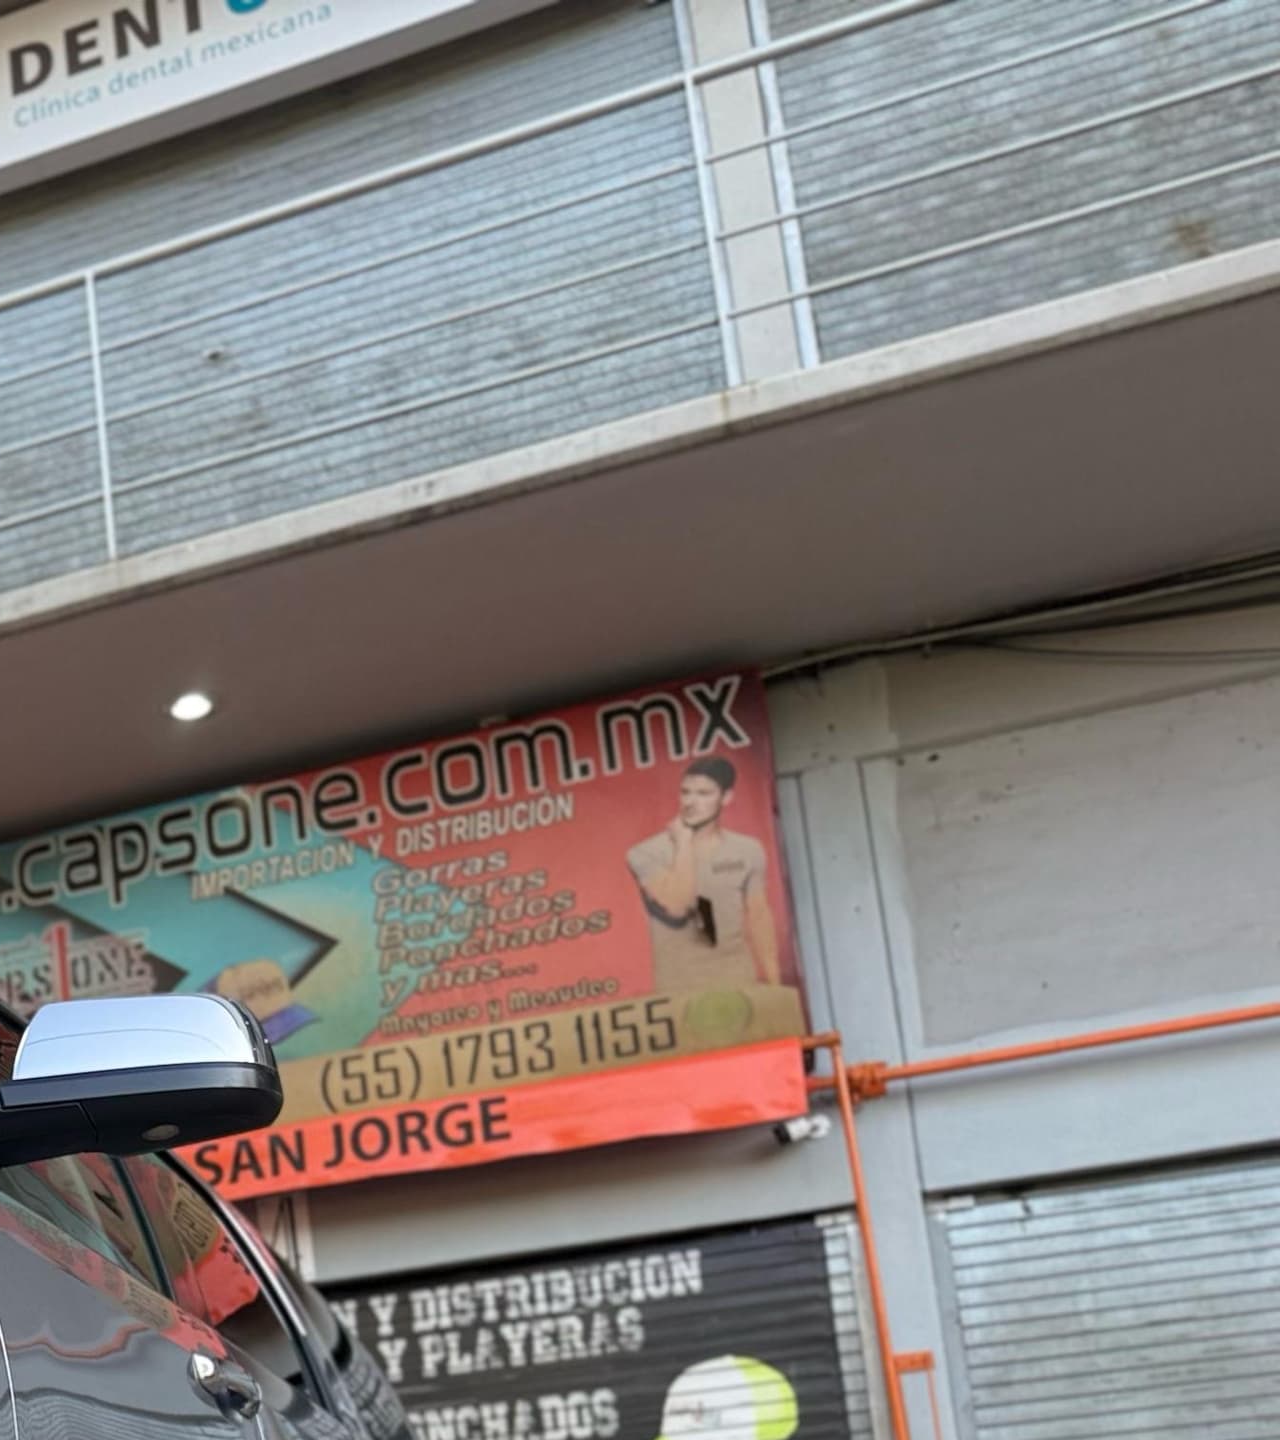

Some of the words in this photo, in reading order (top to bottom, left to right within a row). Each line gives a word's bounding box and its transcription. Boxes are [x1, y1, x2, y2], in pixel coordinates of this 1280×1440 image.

[9, 0, 268, 97] DENT
[108, 48, 193, 96] dental
[200, 5, 333, 64] mexicana
[369, 834, 383, 860] Y
[372, 849, 510, 896] Gorras
[374, 868, 548, 923] Playeras
[378, 889, 575, 950] Bordados
[378, 909, 611, 976] Ponchados
[320, 1047, 424, 1114] (55)
[442, 1020, 555, 1088] 1793
[575, 997, 679, 1066] 1155
[192, 1126, 306, 1188] SAN
[324, 1096, 513, 1170] JORGE
[368, 1294, 397, 1335] Y
[410, 1248, 703, 1332] DISTRIBUCION
[377, 1339, 406, 1382] Y
[418, 1306, 645, 1379] PLAYERAS
